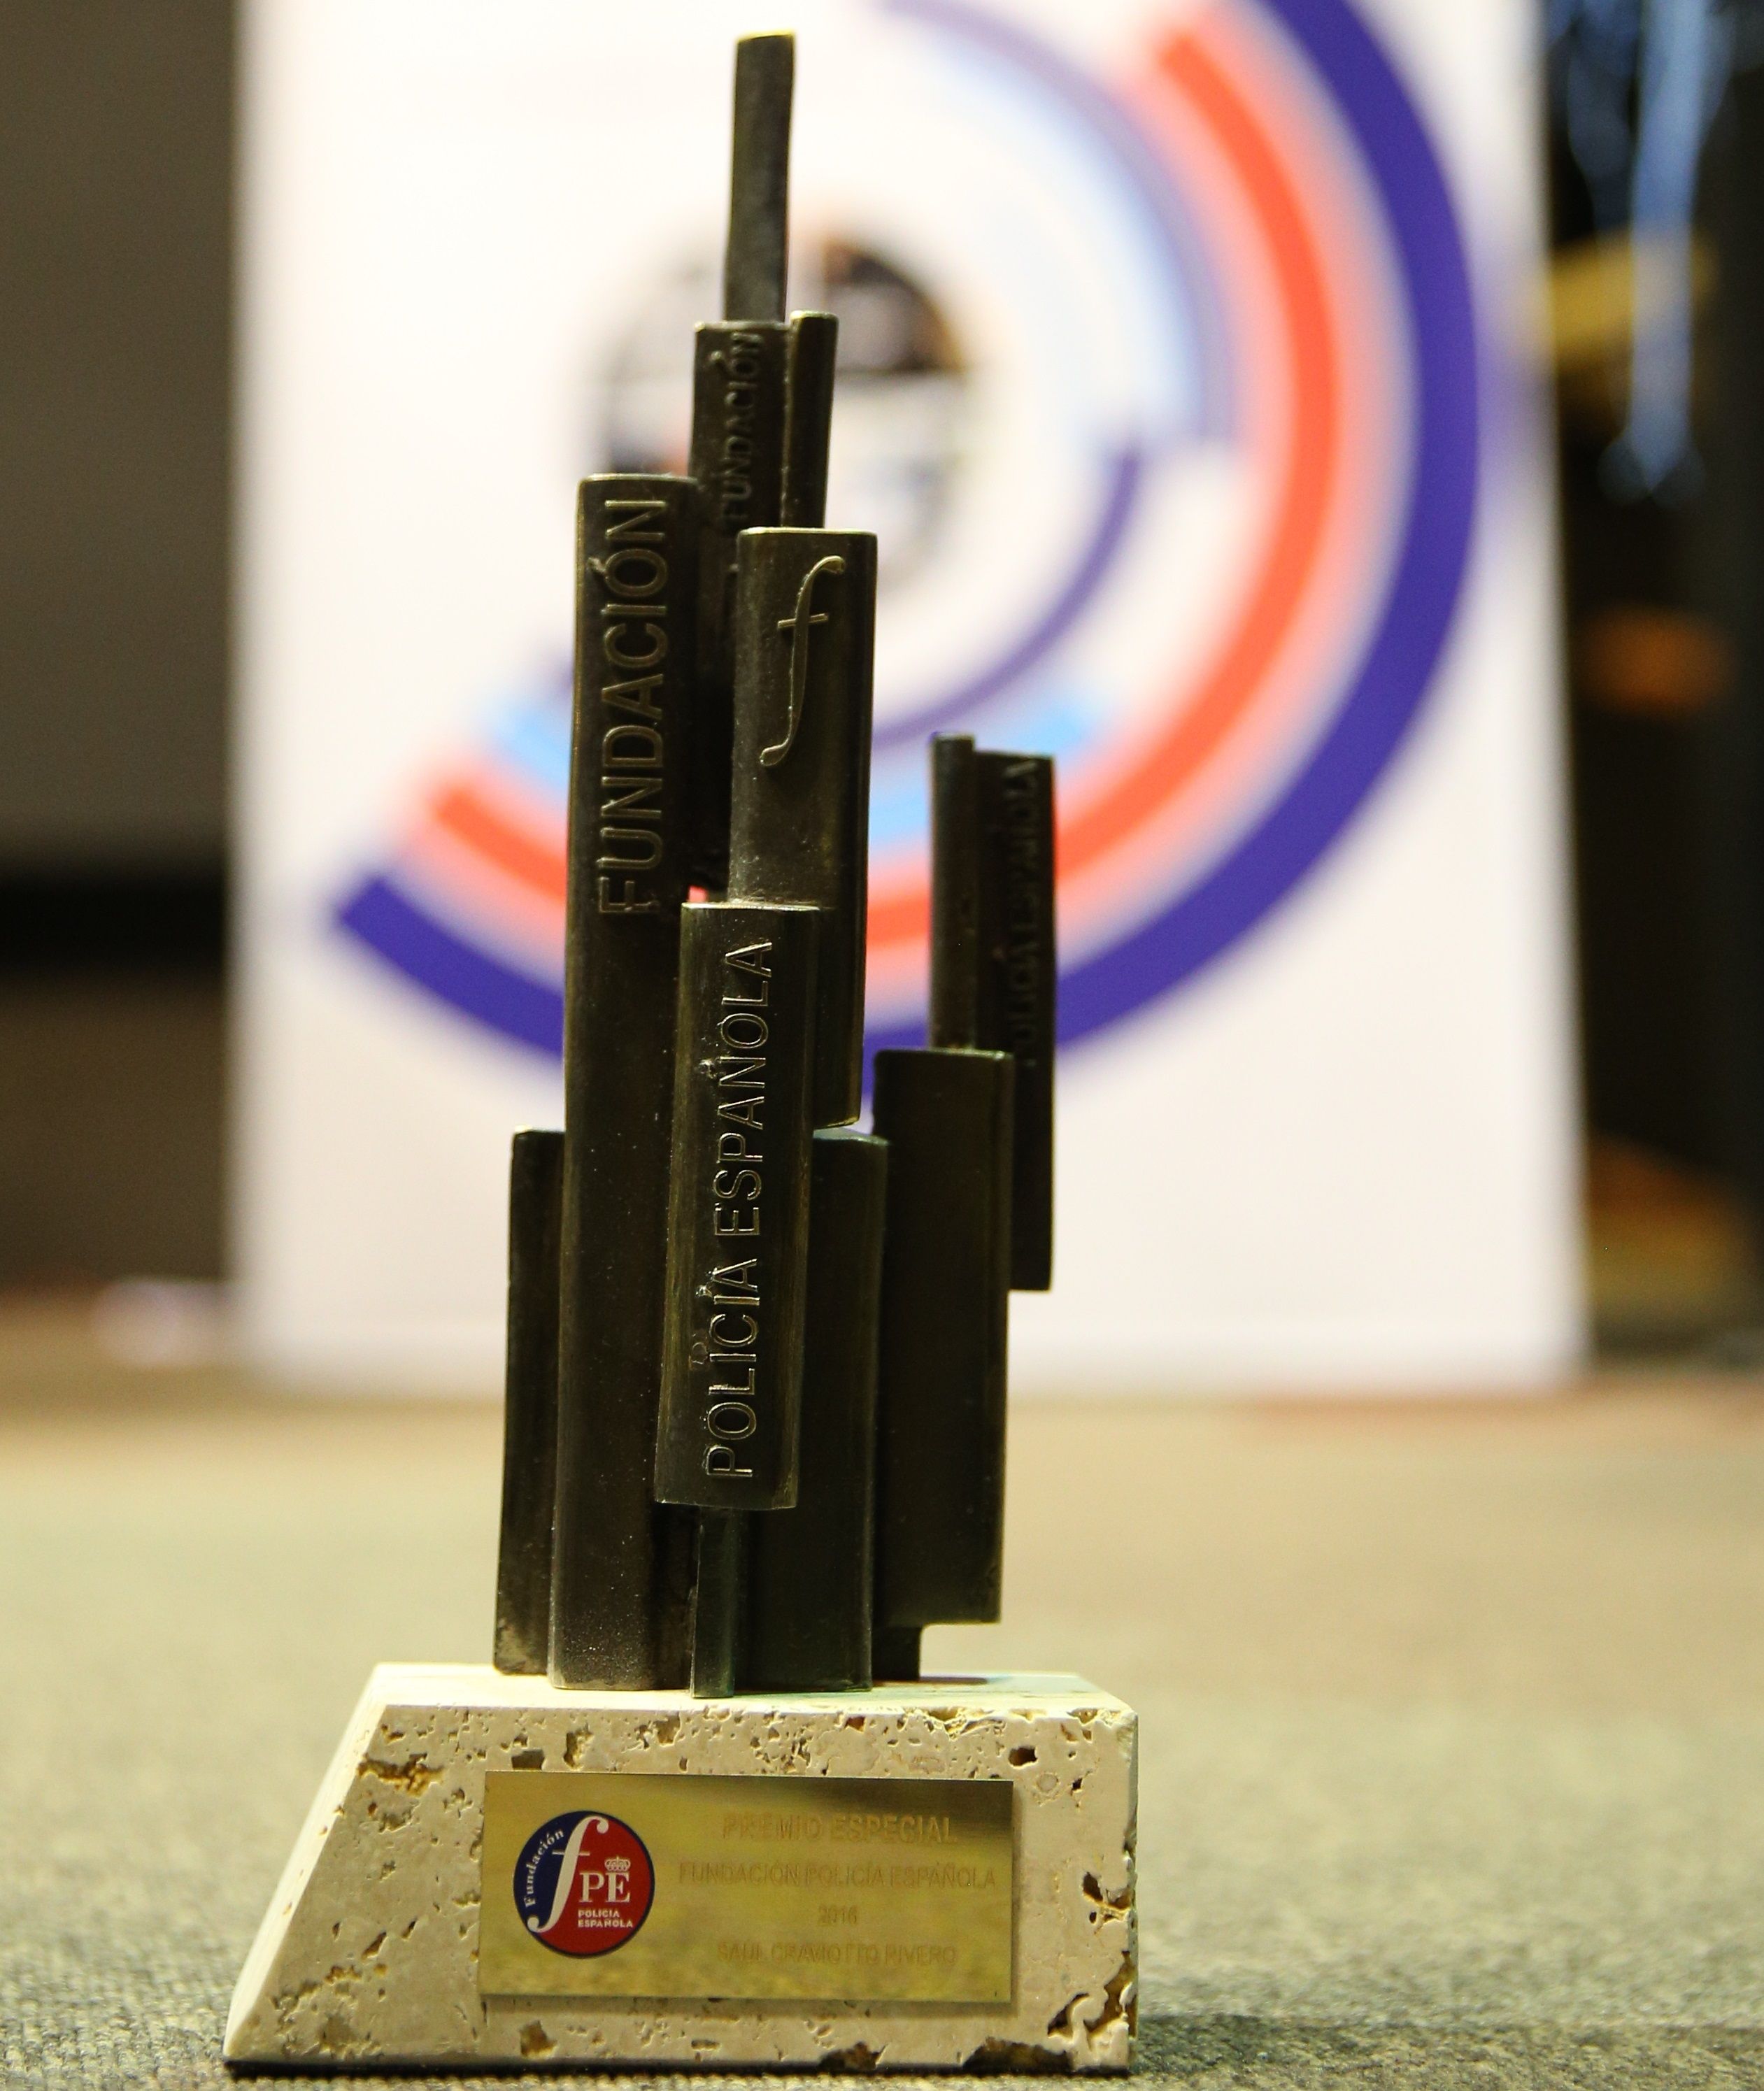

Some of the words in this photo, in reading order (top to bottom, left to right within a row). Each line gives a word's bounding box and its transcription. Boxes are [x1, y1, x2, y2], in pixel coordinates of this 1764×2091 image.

[760, 555, 846, 767] f
[588, 499, 669, 914] FUNDACIÓN
[699, 941, 773, 1236] ESPAÑOLA
[697, 1257, 760, 1478] POLICÍA
[723, 1812, 823, 1841] PREMIO
[830, 1813, 958, 1844] ESPECIAL
[524, 1829, 564, 1908] Fundación
[678, 1859, 800, 1886] FUNDACIÓN
[805, 1860, 884, 1887] POLICÍA
[890, 1862, 996, 1888] ESPAÑOLA
[578, 1871, 631, 1903] PE
[578, 1918, 633, 1928] ESPAÑOLA
[819, 1904, 858, 1927] 2016
[885, 1943, 956, 1966] RIVERO
